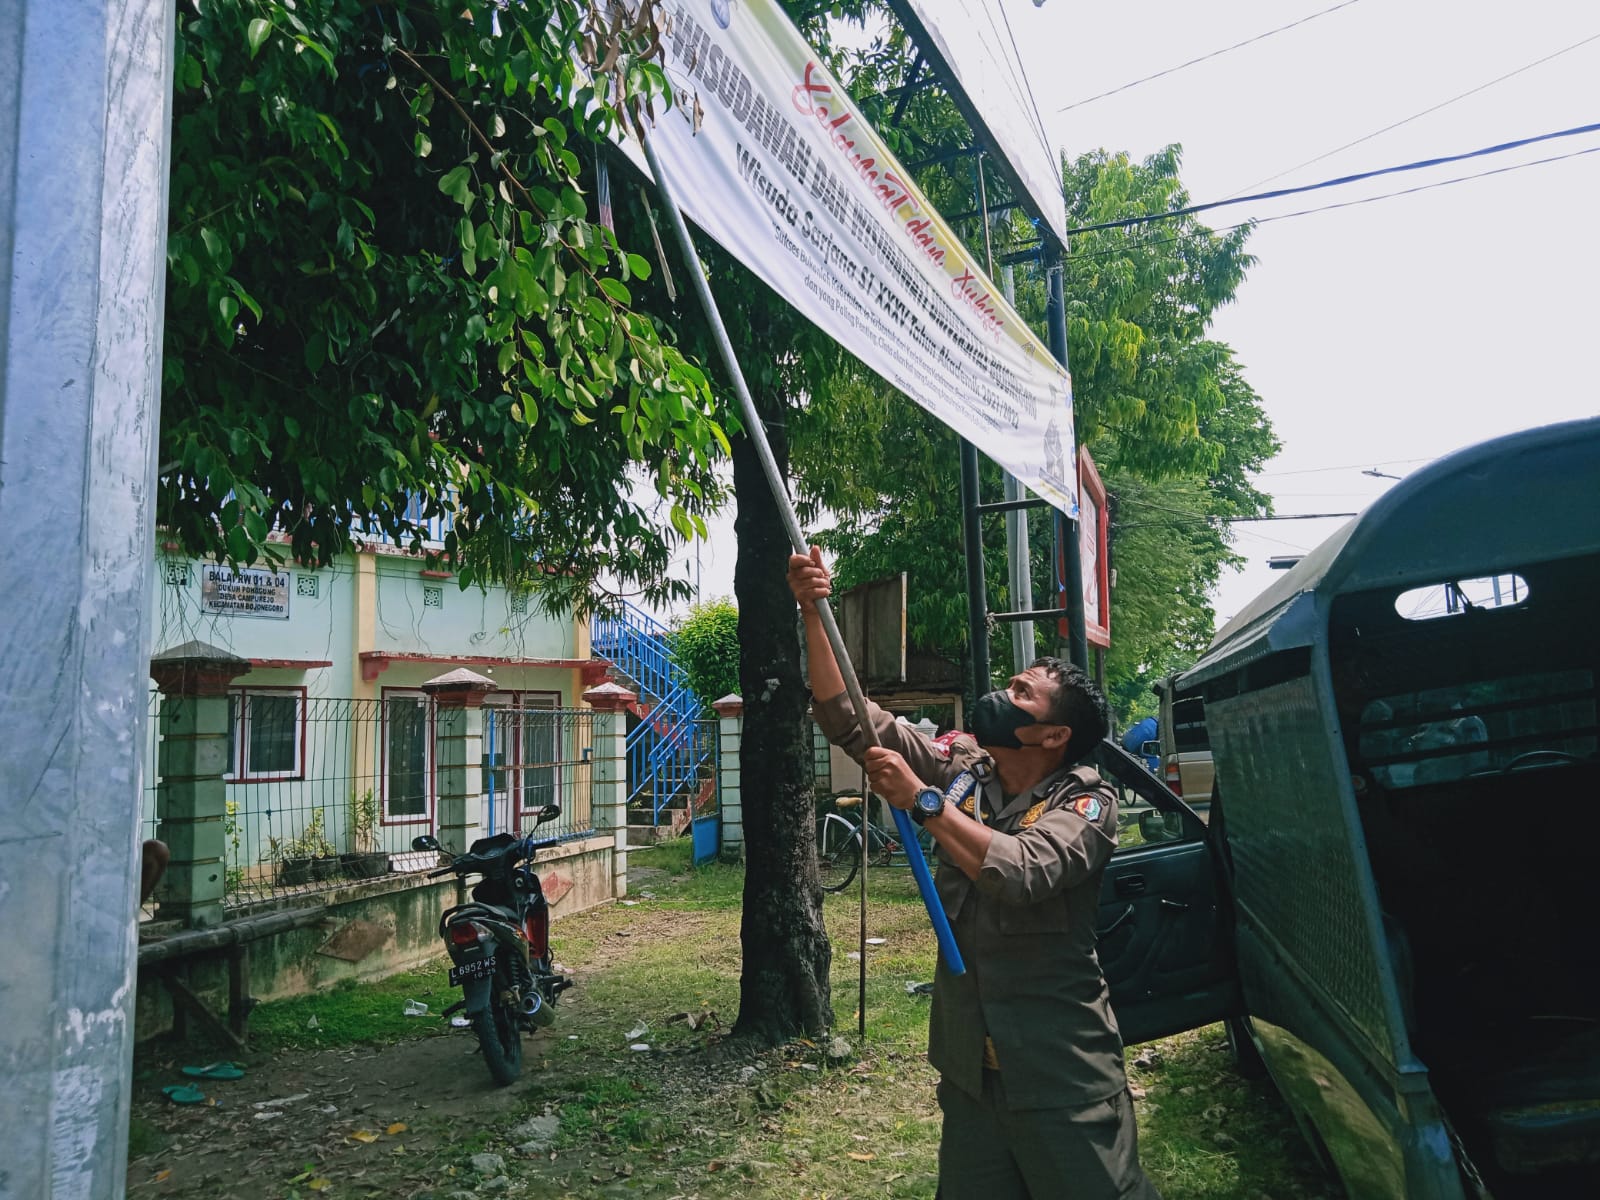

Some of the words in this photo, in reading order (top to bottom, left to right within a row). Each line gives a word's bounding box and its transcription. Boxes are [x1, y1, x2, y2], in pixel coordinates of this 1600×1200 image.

[809, 155, 850, 226] DAN
[737, 143, 801, 226] Wisuda
[801, 210, 856, 279] Sarjana
[239, 574, 251, 584] RW
[253, 575, 263, 585] 01
[266, 577, 272, 586] &
[275, 577, 285, 587] 04
[220, 592, 236, 601] DESA
[245, 602, 284, 613] BOJONEGORO
[451, 969, 457, 978] L
[459, 960, 482, 976] 6952
[484, 956, 496, 968] WS
